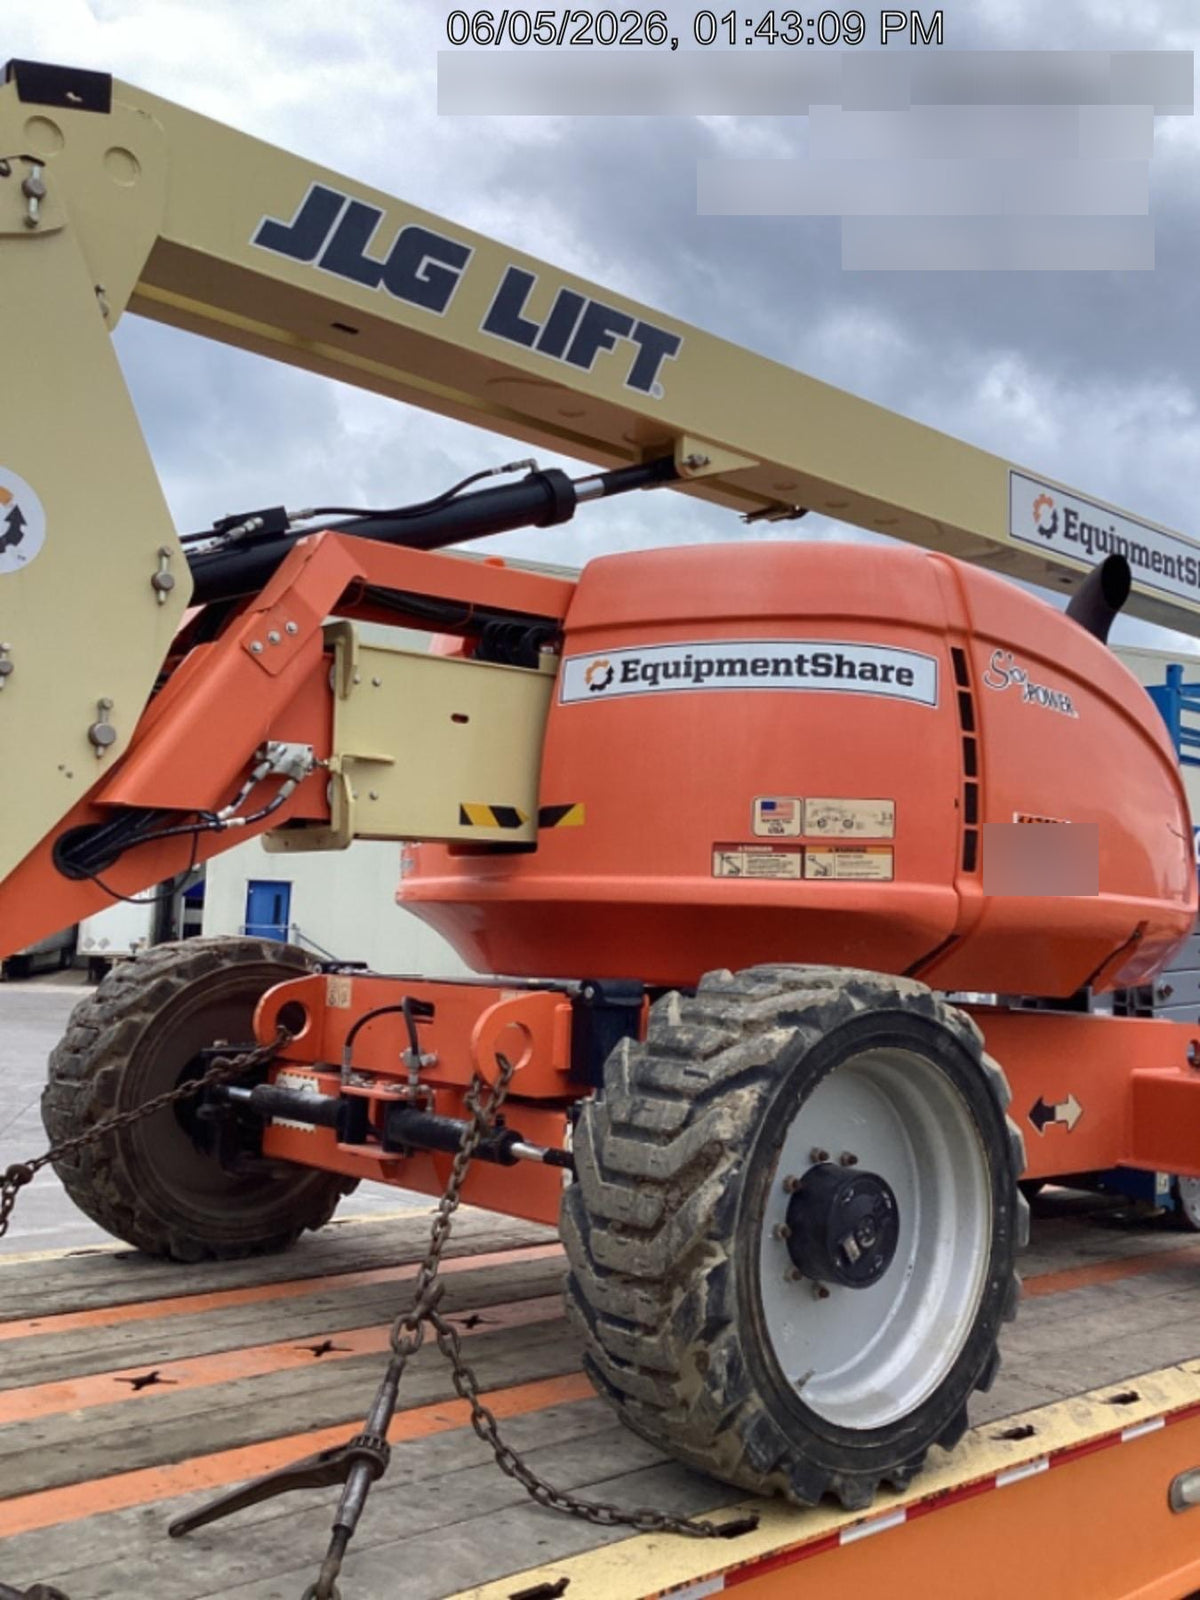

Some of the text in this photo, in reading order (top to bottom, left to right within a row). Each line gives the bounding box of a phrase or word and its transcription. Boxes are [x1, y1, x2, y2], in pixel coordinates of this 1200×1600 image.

[250, 182, 683, 394] JLG LIFT
[619, 652, 915, 687] EquipmentShare
